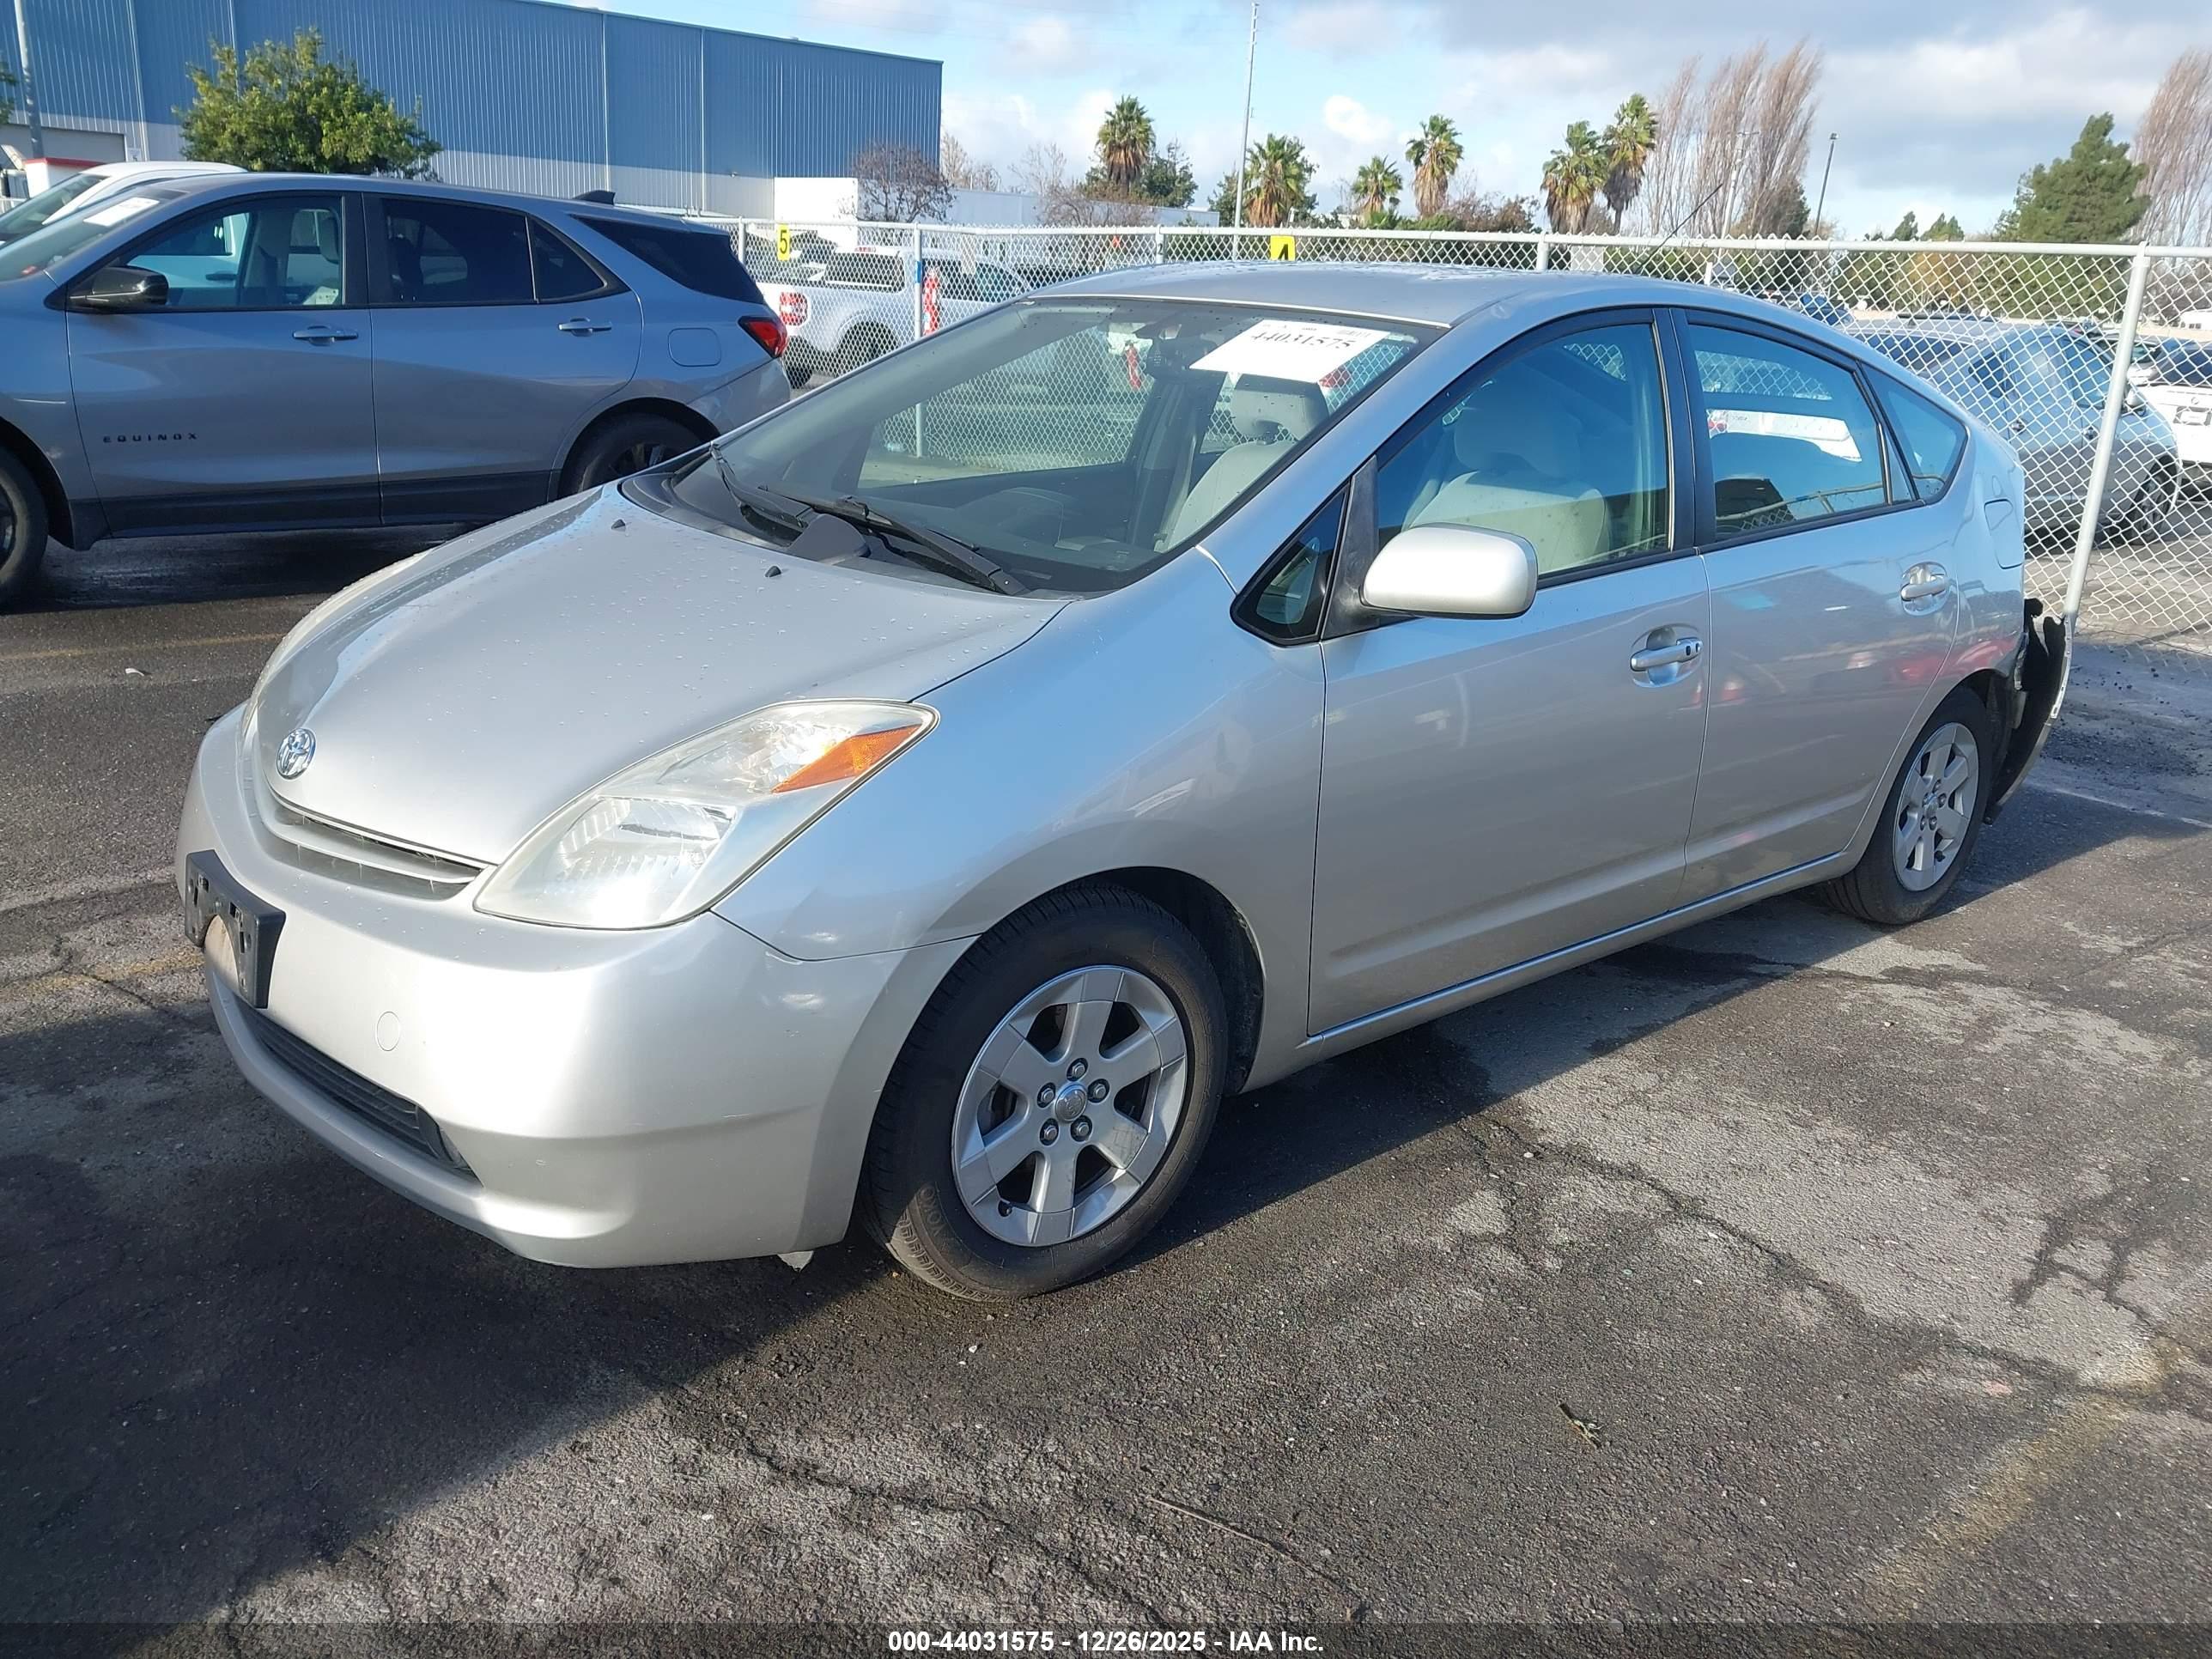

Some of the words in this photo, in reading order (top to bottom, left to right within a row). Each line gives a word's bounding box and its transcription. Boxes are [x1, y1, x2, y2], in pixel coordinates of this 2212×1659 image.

[779, 228, 788, 255] 5
[1251, 331, 1356, 349] 44031575
[102, 432, 198, 444] EQUINOX
